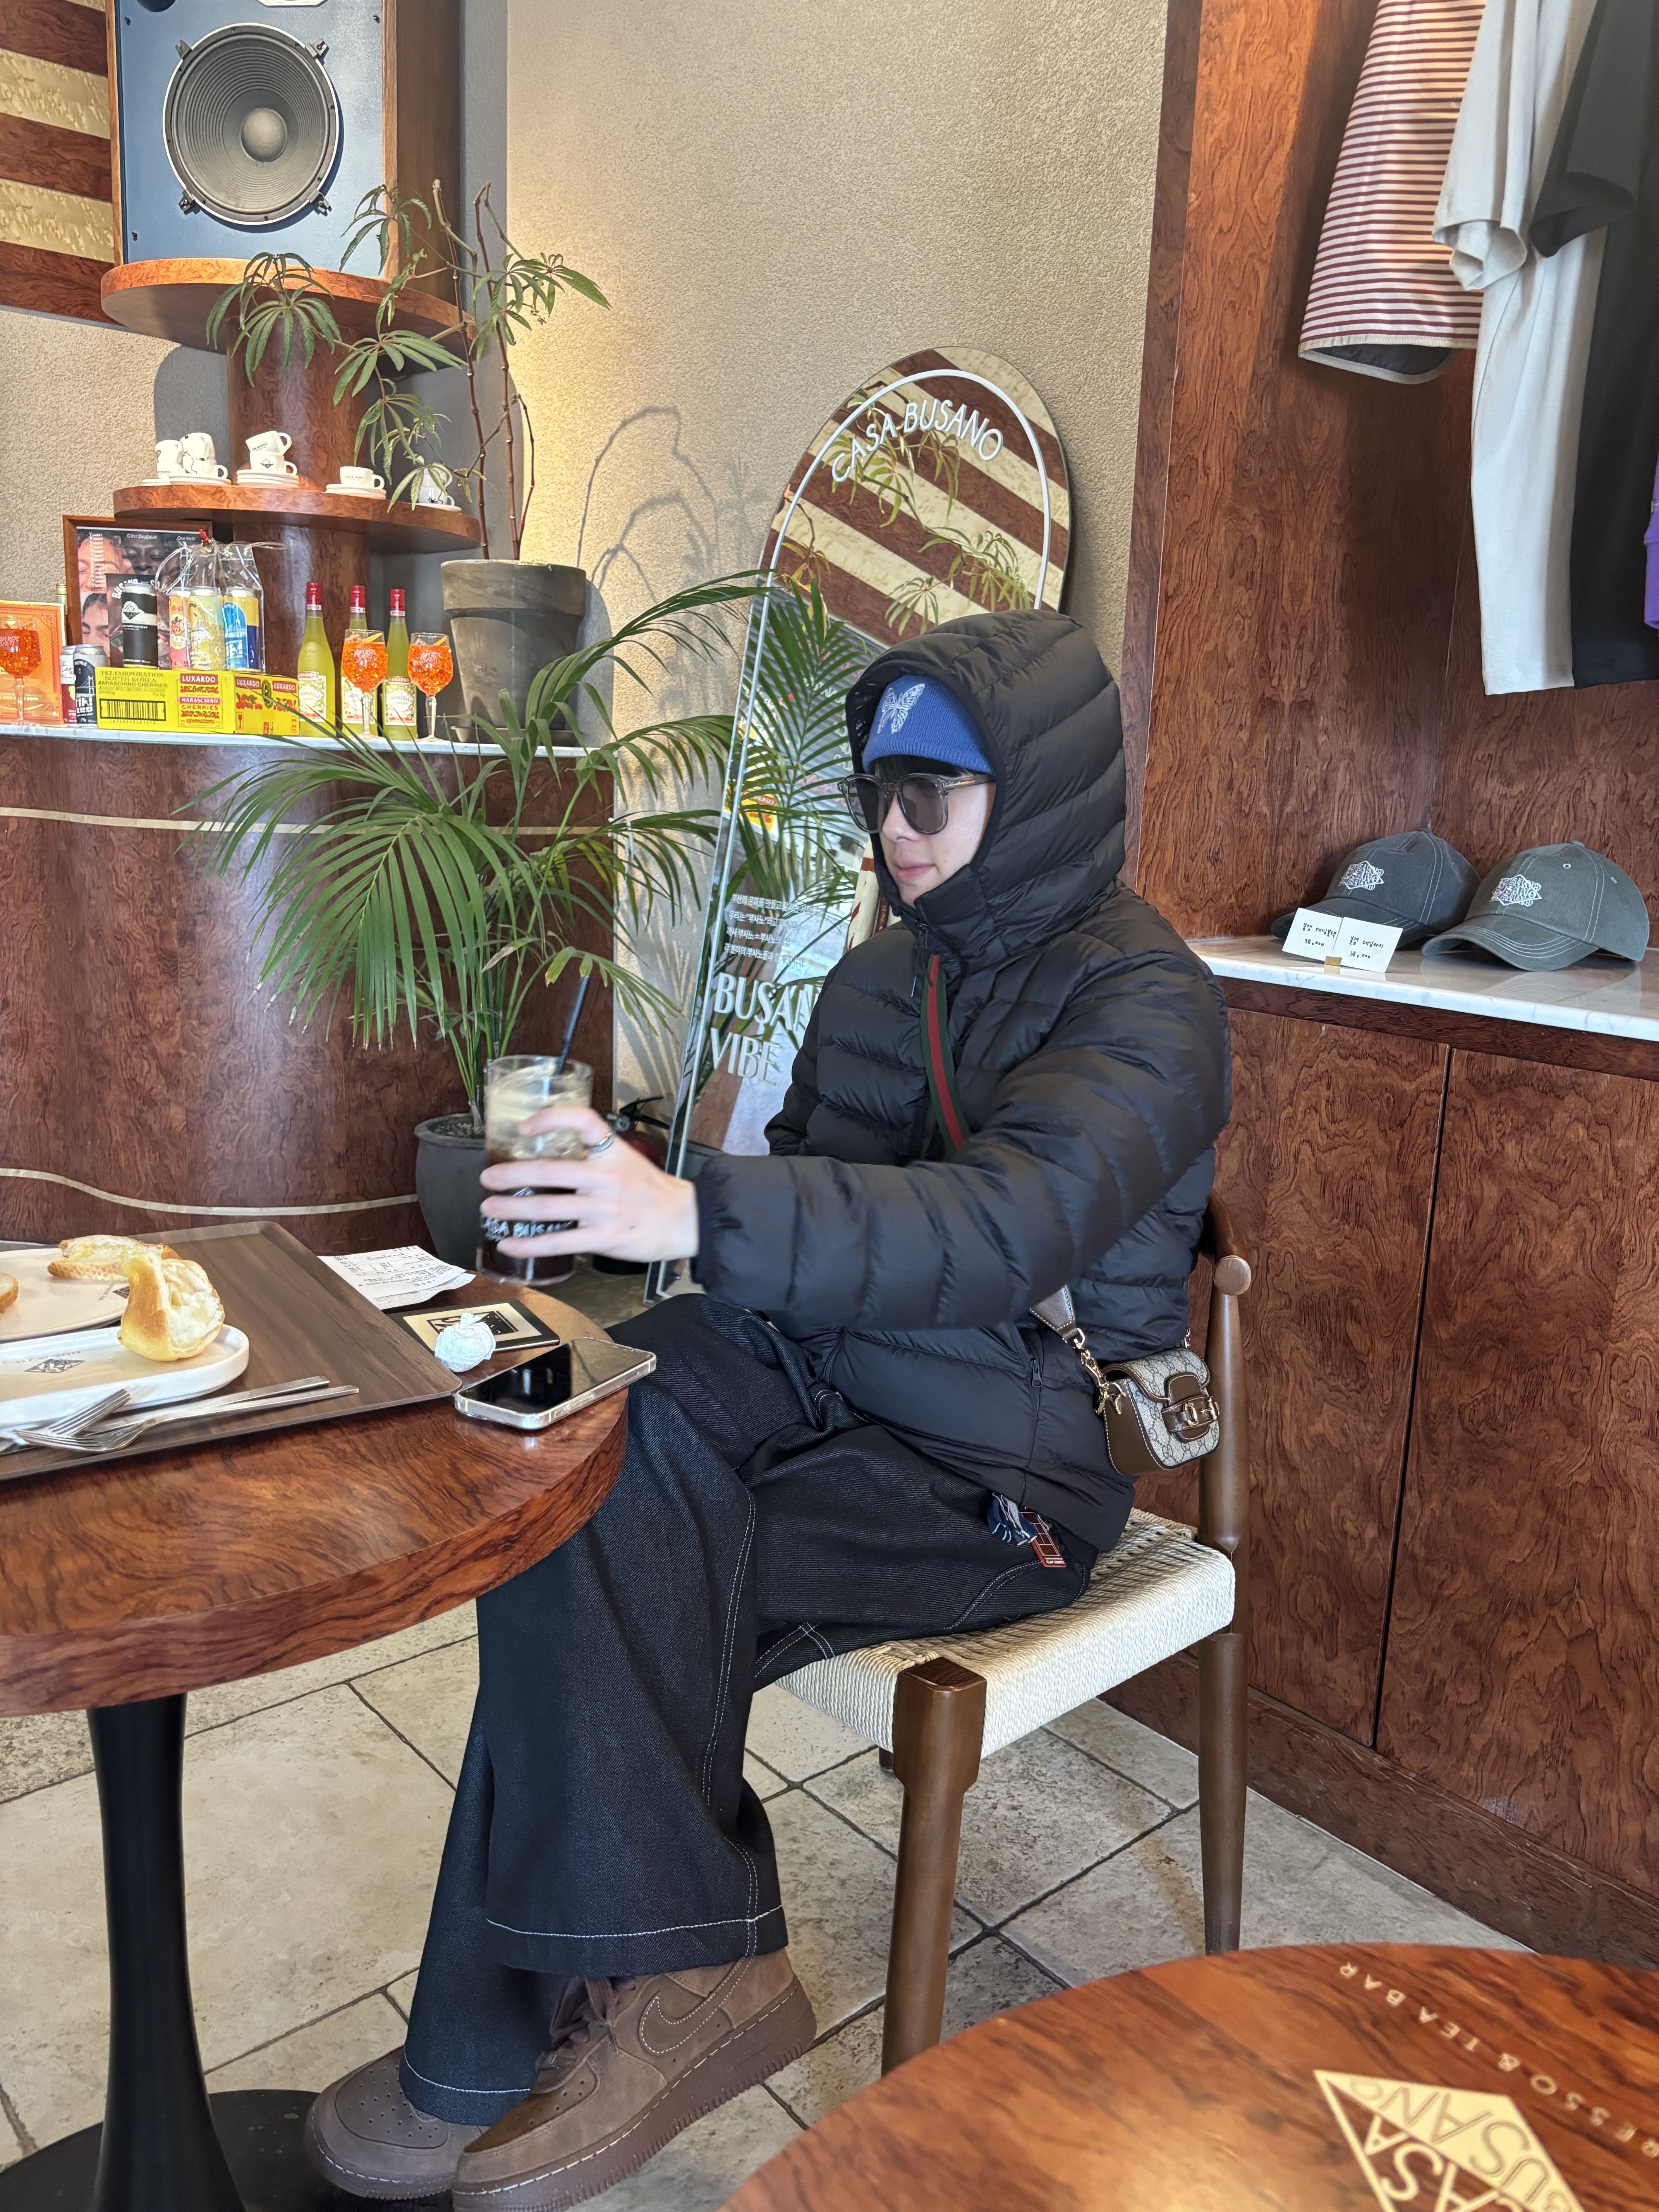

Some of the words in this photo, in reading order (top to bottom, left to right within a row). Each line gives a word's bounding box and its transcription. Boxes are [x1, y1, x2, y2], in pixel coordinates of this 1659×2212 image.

[831, 413, 897, 483] CASA
[903, 398, 1003, 461] BUSANO
[237, 679, 260, 687] LUXARDO
[732, 893, 748, 905] 부산의
[729, 910, 746, 922] 우리는
[1305, 938, 1324, 946] 38,000
[711, 1027, 777, 1086] VIBE
[1340, 1961, 1406, 2006] BAR
[1419, 2006, 1480, 2052] TEA
[1498, 2052, 1521, 2072] &
